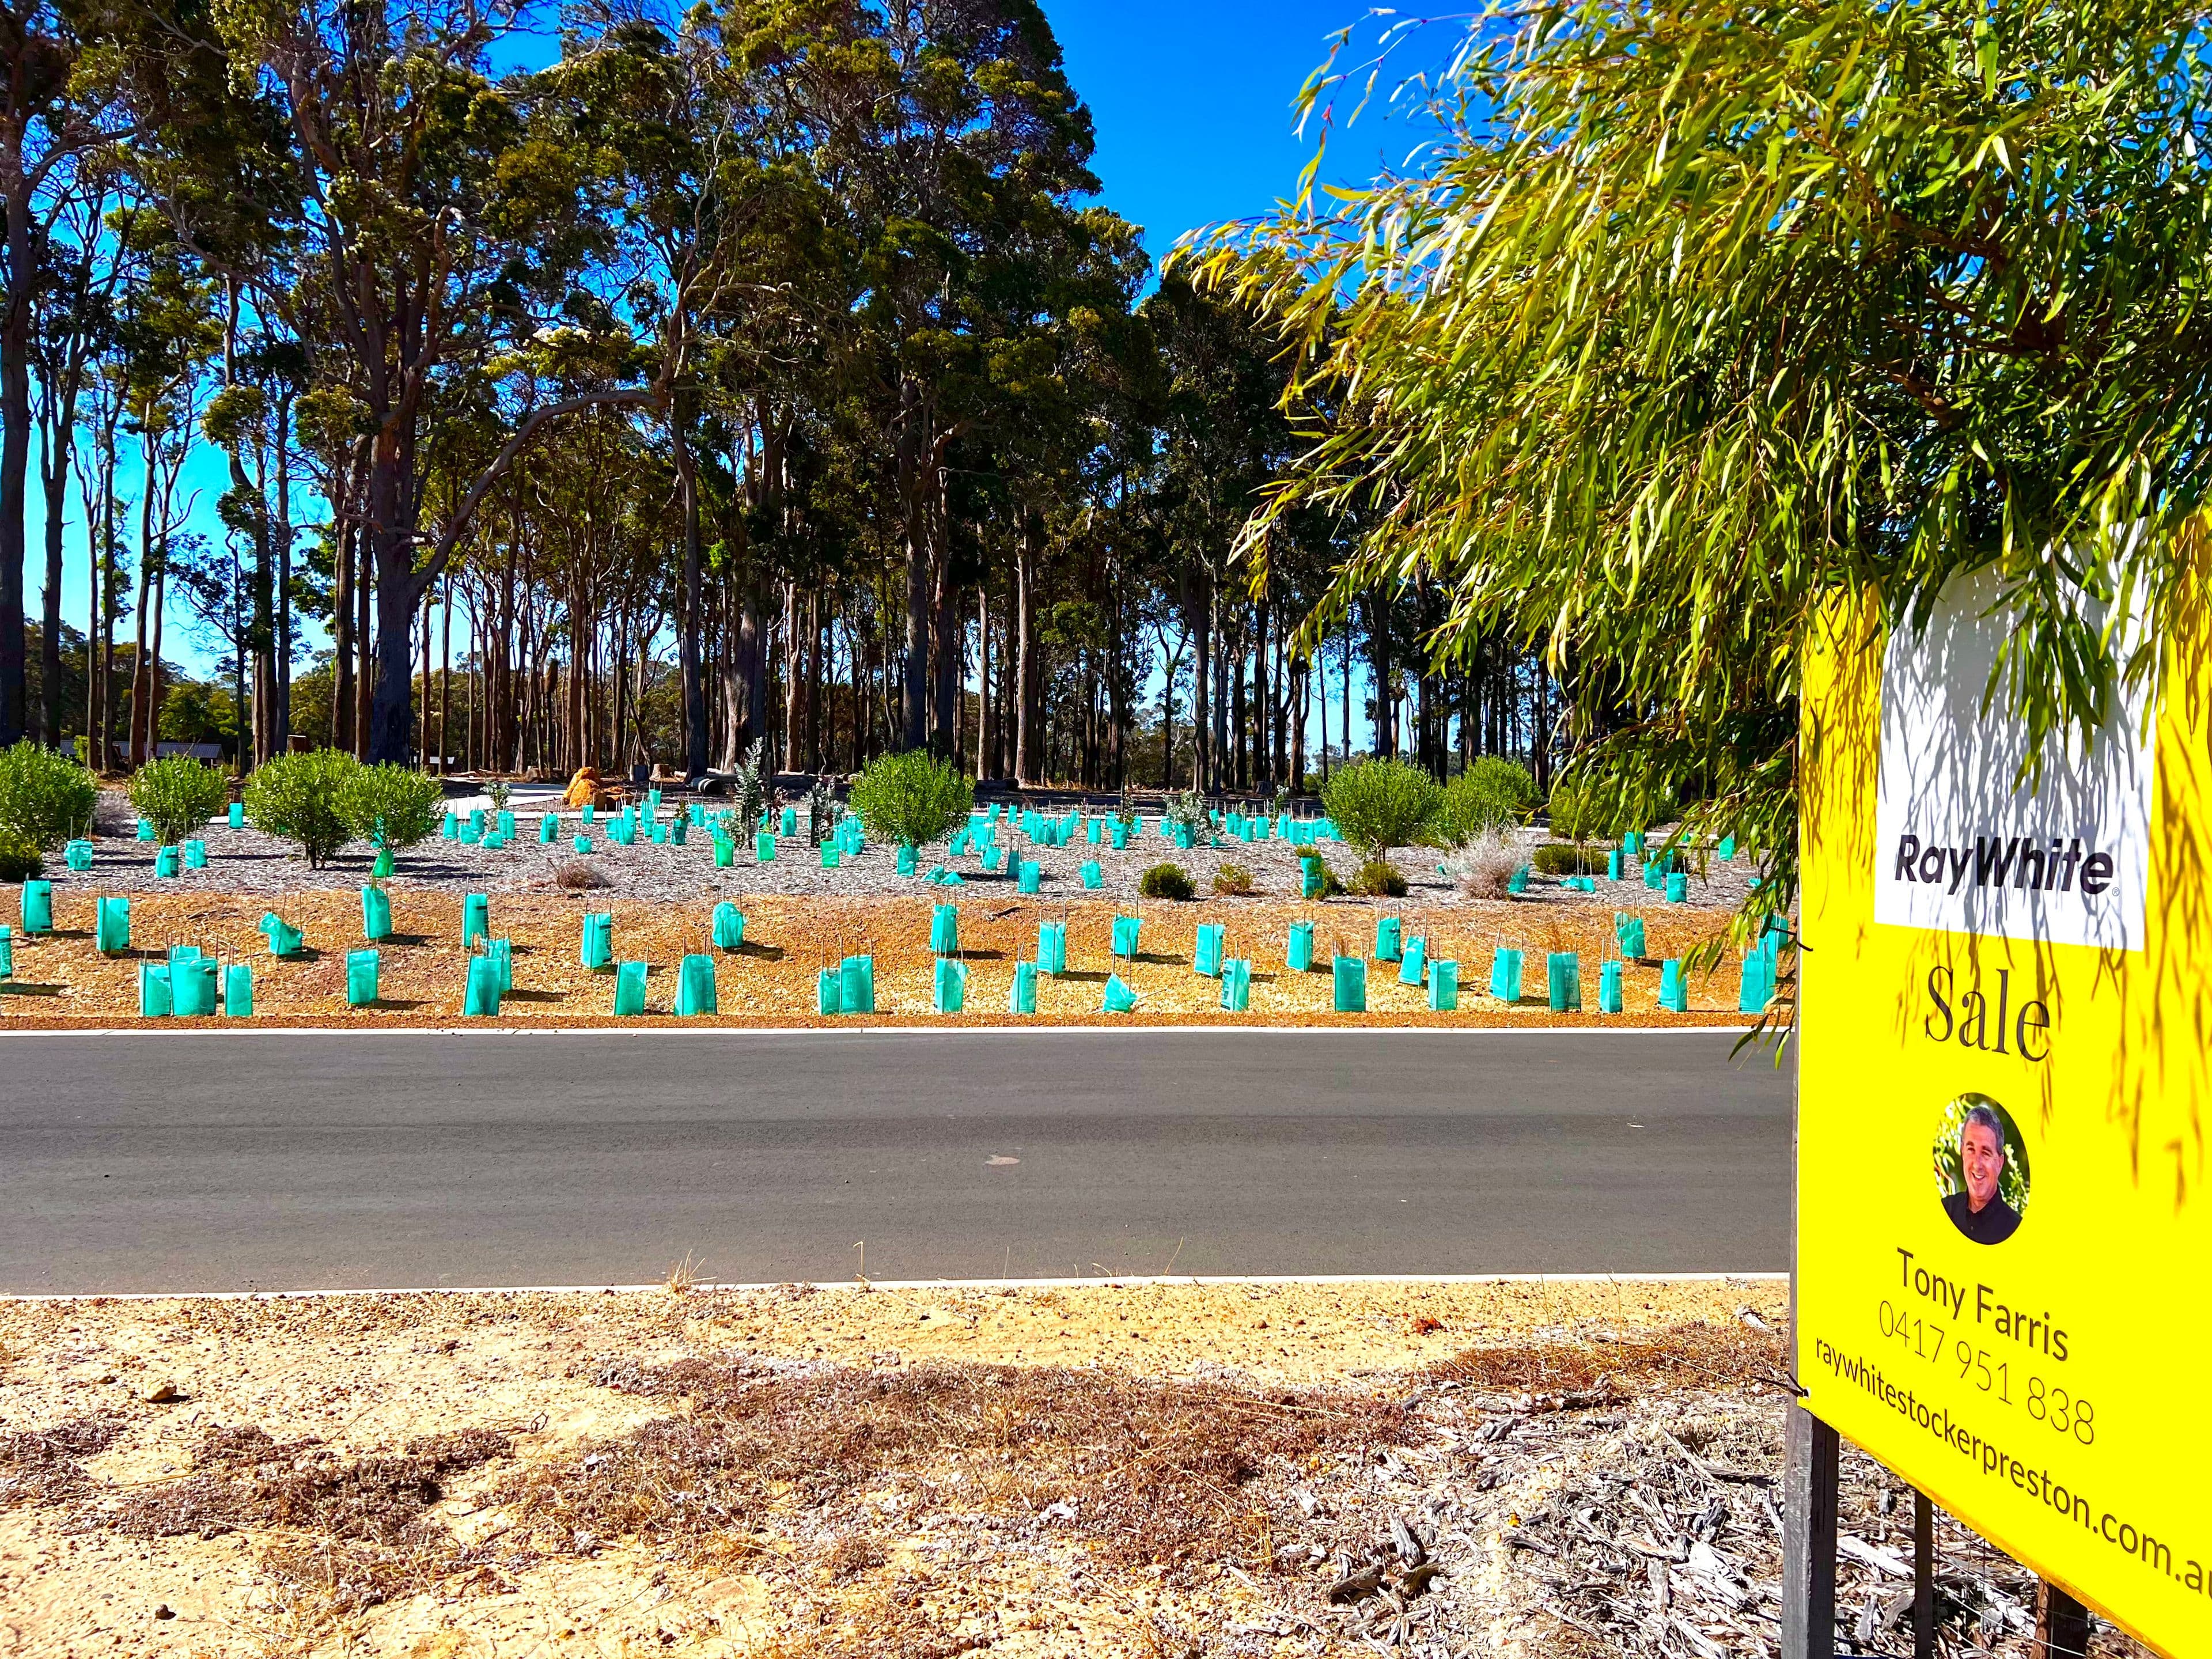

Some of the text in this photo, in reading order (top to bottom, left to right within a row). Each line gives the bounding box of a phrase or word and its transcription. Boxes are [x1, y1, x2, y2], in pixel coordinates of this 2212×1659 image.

[1925, 965, 2051, 1062] Sale
[1897, 1247, 2069, 1362] Tony Farris
[1879, 1300, 2094, 1445] 0417 951 838
[1816, 1338, 2212, 1600] raywhitestockerpreston.com.a
